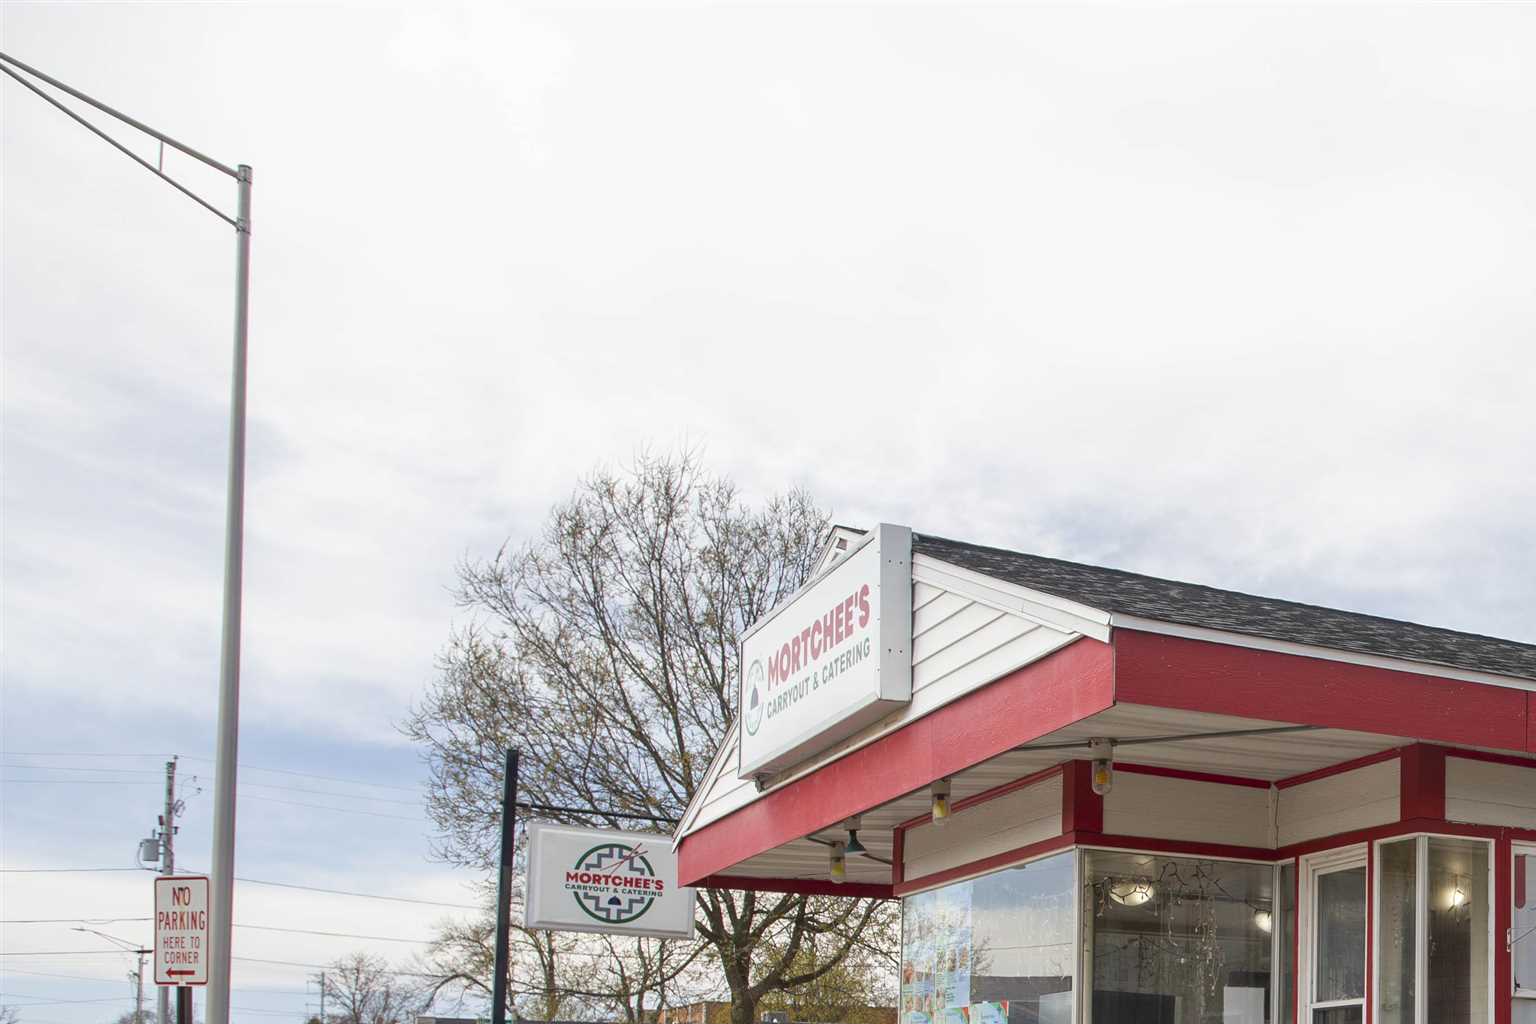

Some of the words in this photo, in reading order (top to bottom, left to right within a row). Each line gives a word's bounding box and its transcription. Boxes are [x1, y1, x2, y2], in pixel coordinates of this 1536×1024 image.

[767, 584, 870, 691] MORTCHEE'S
[766, 676, 810, 719] CARRYOUT
[812, 671, 819, 690] &
[822, 637, 871, 685] CATERING
[565, 883, 610, 893] CARRYOUT
[621, 888, 663, 897] CATERING
[566, 872, 664, 890] MORTCHEE'S
[172, 887, 191, 906] NO
[158, 911, 206, 930] PARKING
[163, 937, 186, 949] HERE
[190, 937, 200, 949] TO
[164, 952, 199, 964] CORNER
